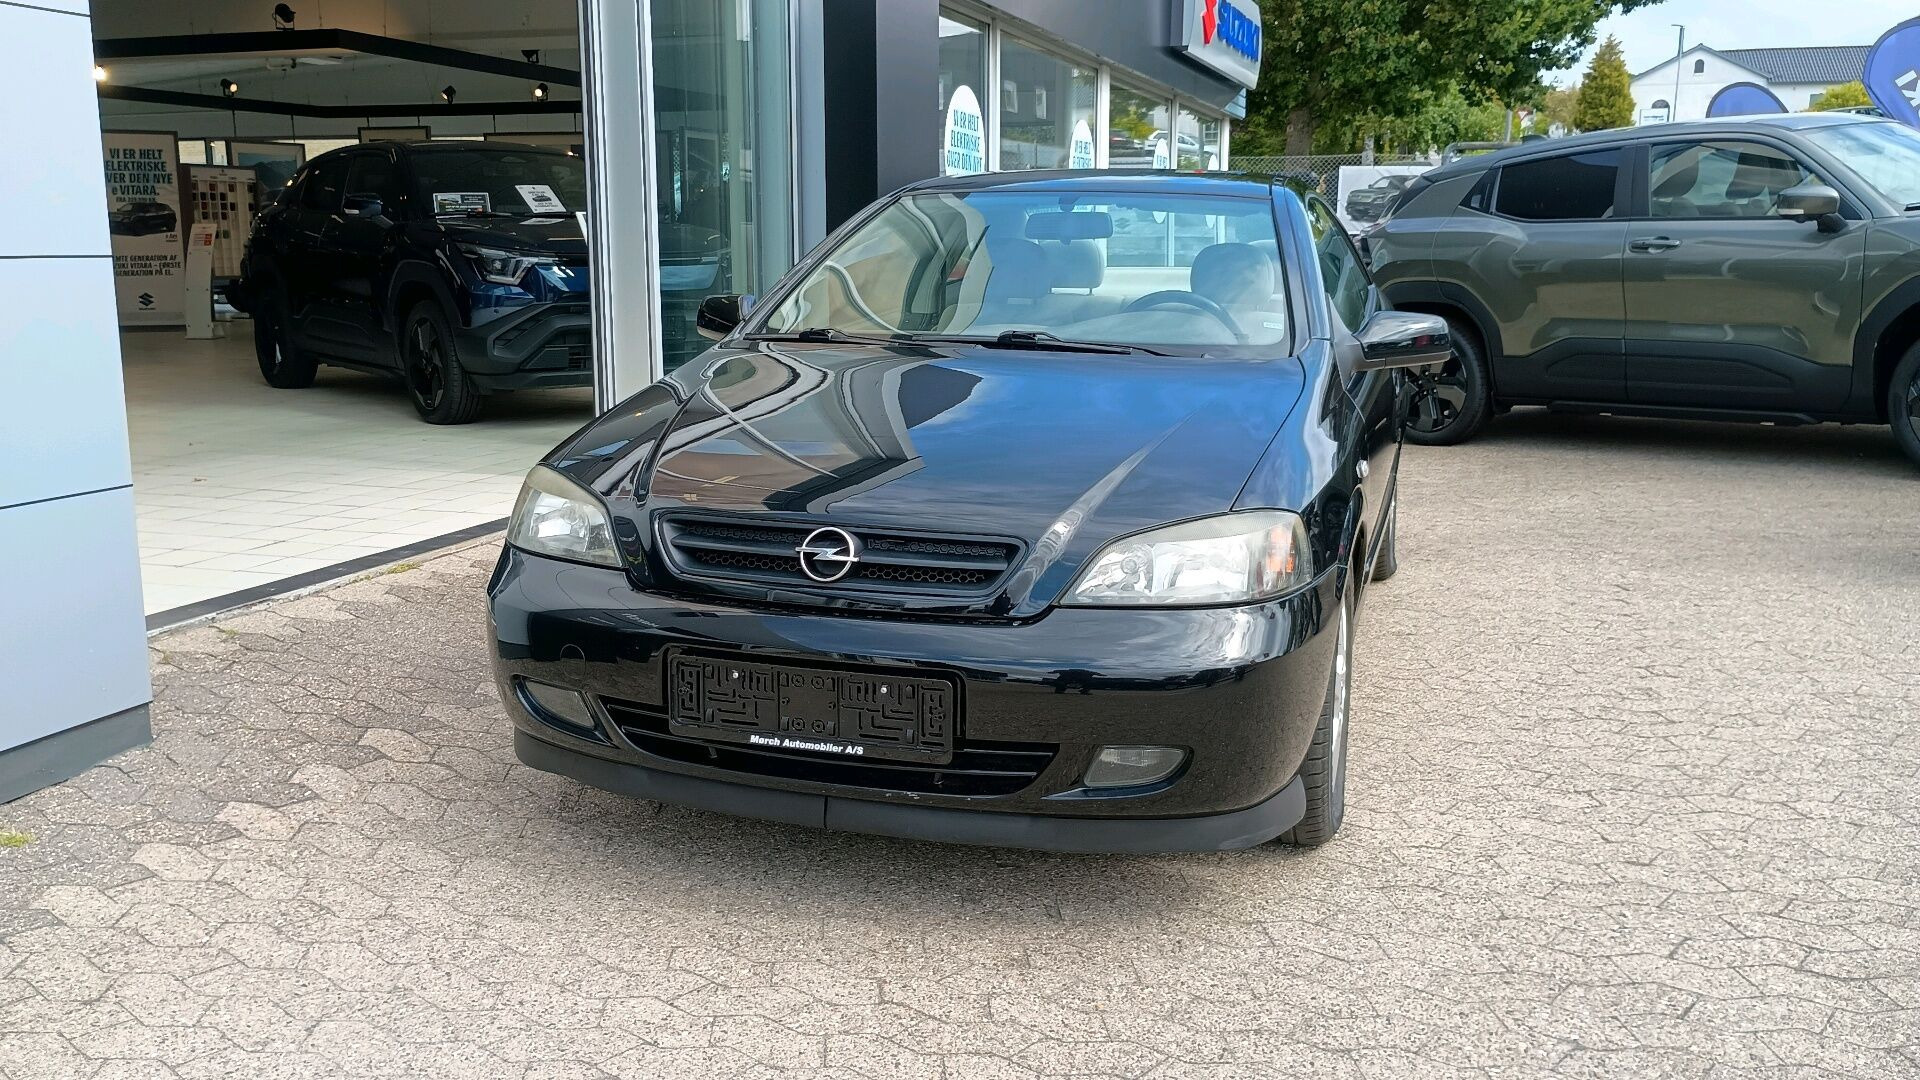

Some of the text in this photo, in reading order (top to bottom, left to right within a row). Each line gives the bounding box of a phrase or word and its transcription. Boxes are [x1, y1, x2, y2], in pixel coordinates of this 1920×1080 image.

[109, 147, 163, 161] VI ER HELT
[105, 160, 168, 173] ELEKTRISKE
[105, 172, 173, 185] VER DEN NYE
[783, 739, 844, 753] Automobiler
[845, 745, 864, 755] A/S
